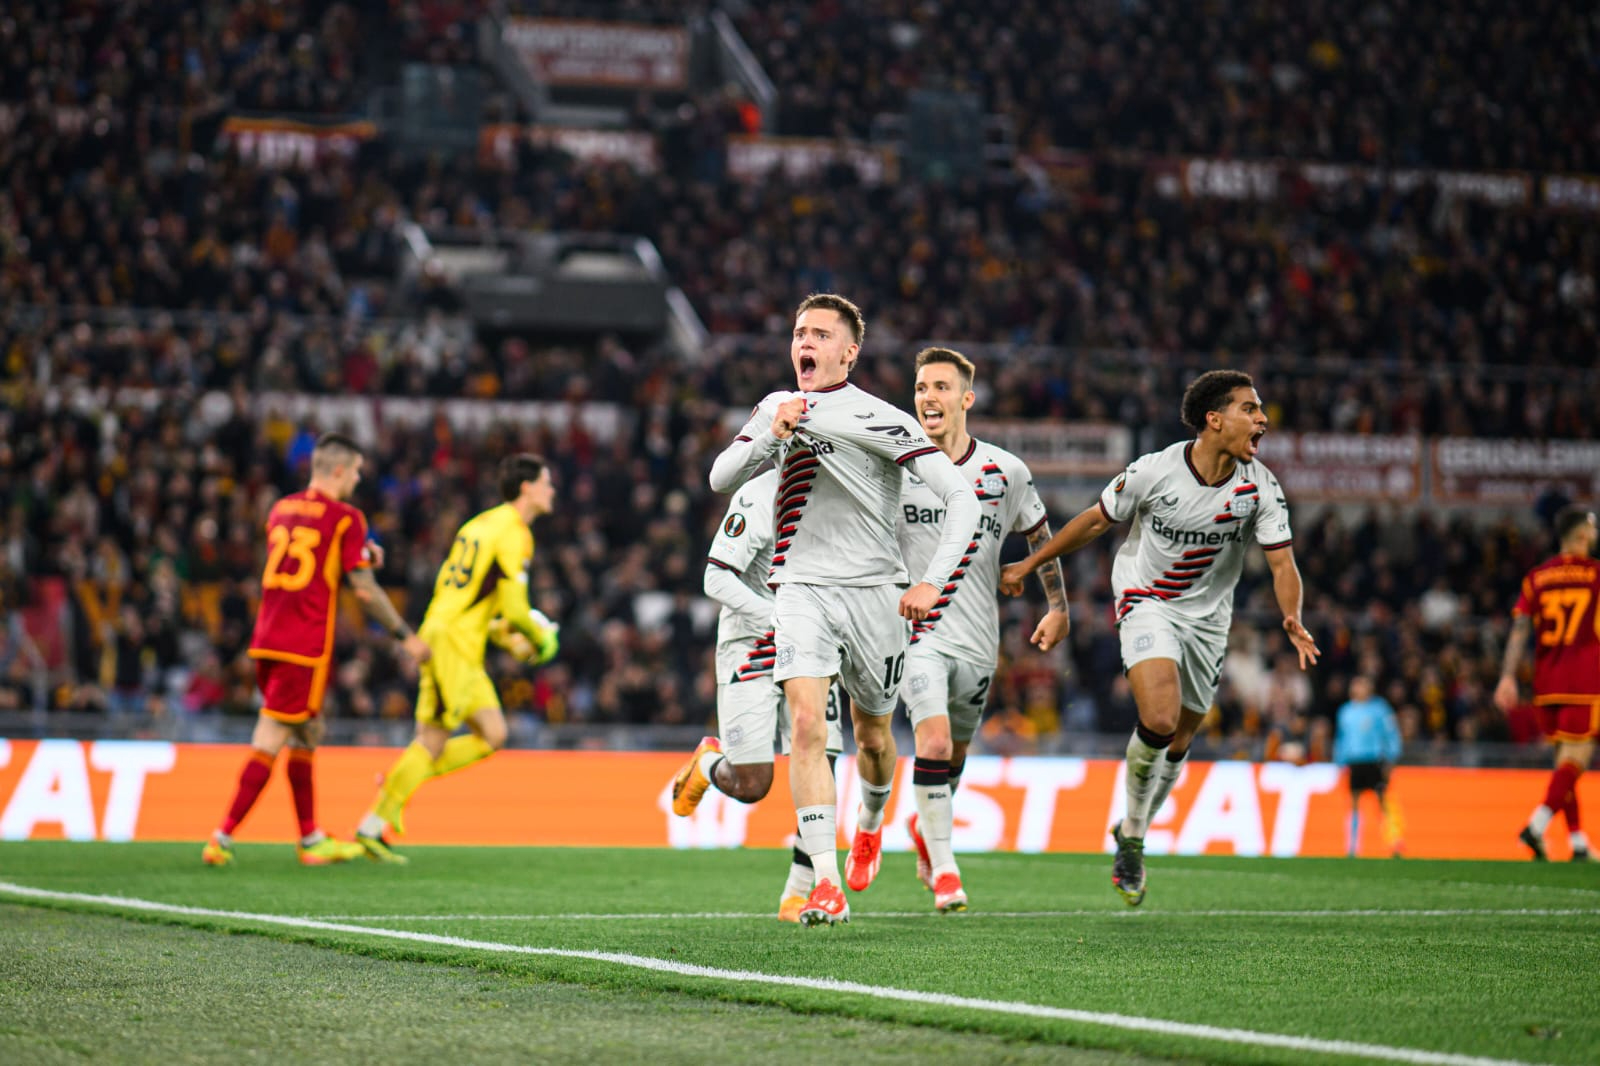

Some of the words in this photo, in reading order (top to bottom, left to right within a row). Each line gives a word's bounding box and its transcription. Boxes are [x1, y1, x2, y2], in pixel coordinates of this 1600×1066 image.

[903, 504, 1001, 539] Barnia
[262, 524, 321, 592] 23
[1539, 588, 1592, 646] 37
[884, 650, 905, 690] 10
[0, 738, 176, 842] AT
[782, 754, 1087, 853] UST
